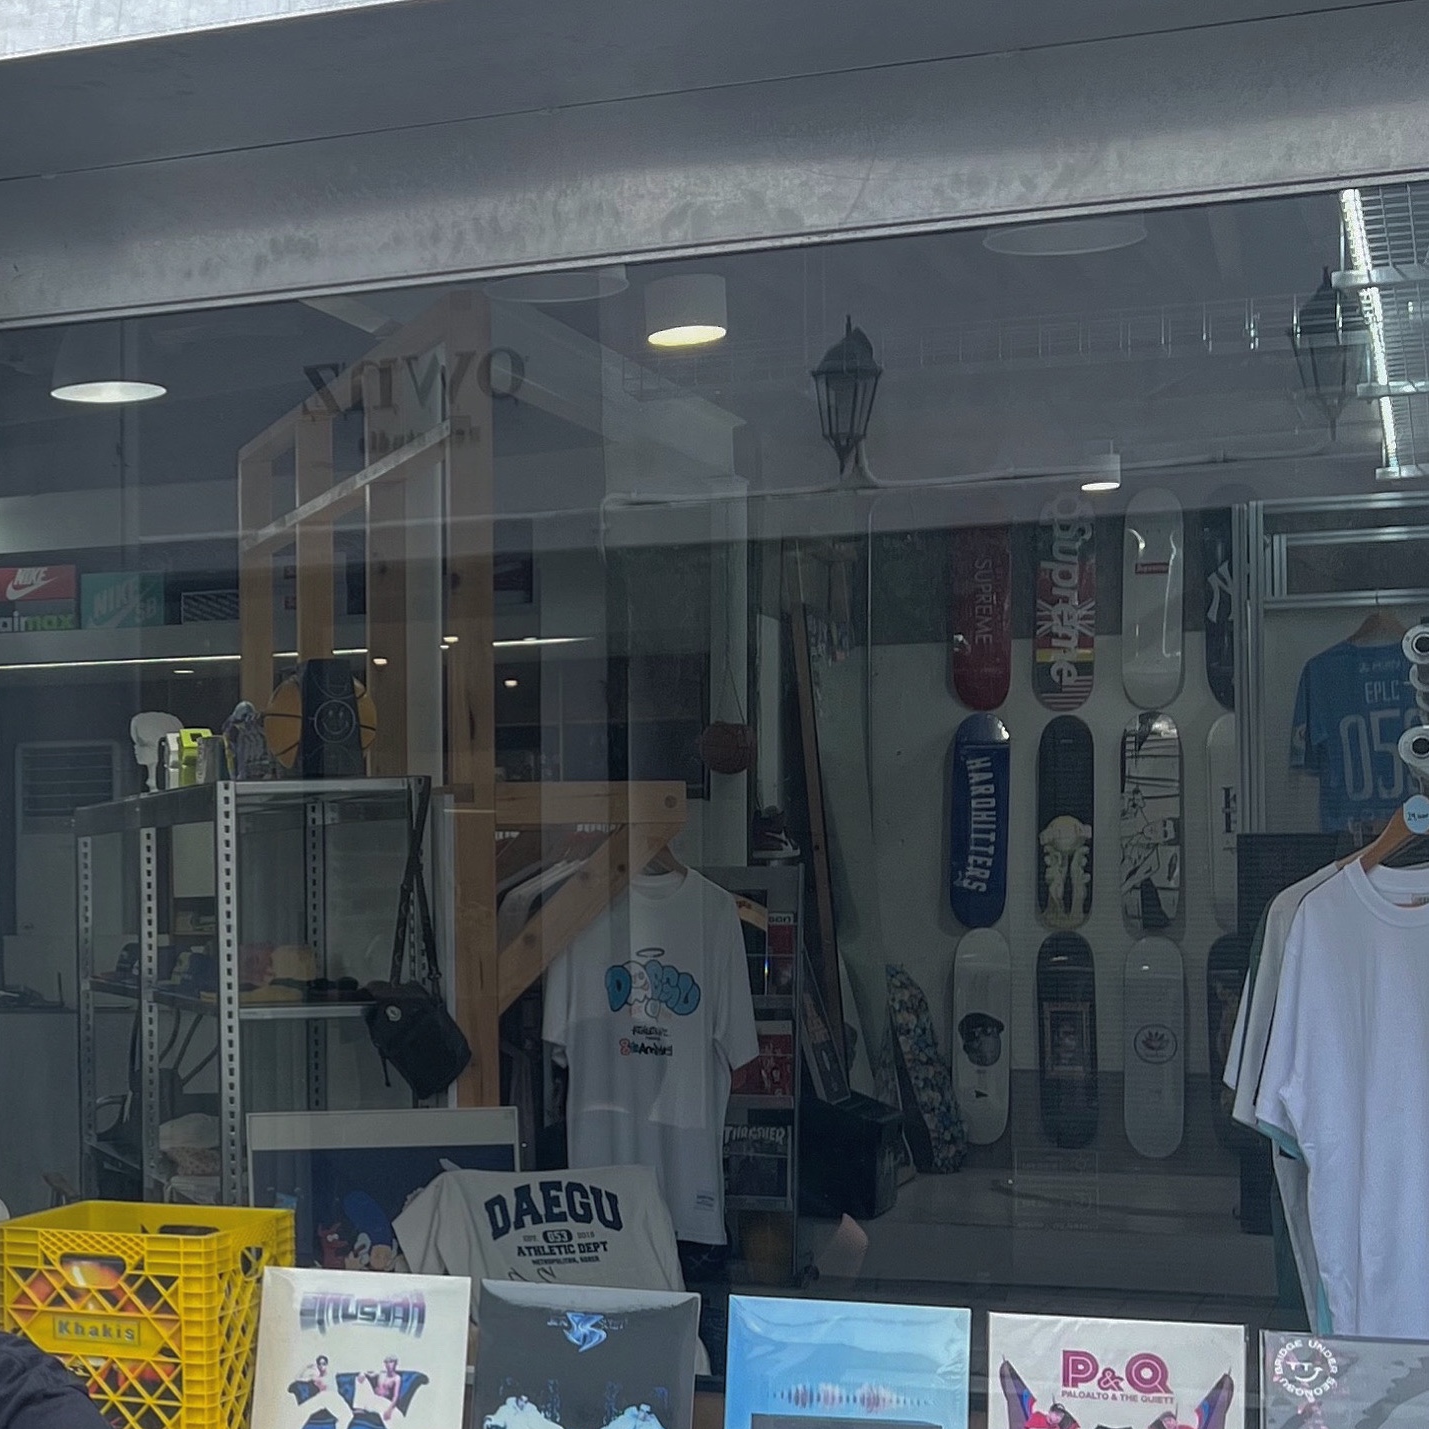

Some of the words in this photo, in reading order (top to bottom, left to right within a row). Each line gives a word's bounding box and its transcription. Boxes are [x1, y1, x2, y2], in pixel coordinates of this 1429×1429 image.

[14, 567, 48, 586] NIKE
[974, 558, 994, 645] SUPREME
[1364, 679, 1400, 703] EPLC
[484, 1181, 623, 1241] DAEGU
[546, 1231, 568, 1242] 053
[517, 1244, 575, 1257] ATHLETIC
[577, 1241, 608, 1254] DEPT
[57, 1319, 136, 1342] Khakis
[1274, 1339, 1304, 1375] BRIDGE
[1308, 1339, 1339, 1374] UNDER
[1060, 1349, 1174, 1395] P&Q
[1062, 1389, 1110, 1401] PALOALTO
[1120, 1393, 1139, 1402] THE
